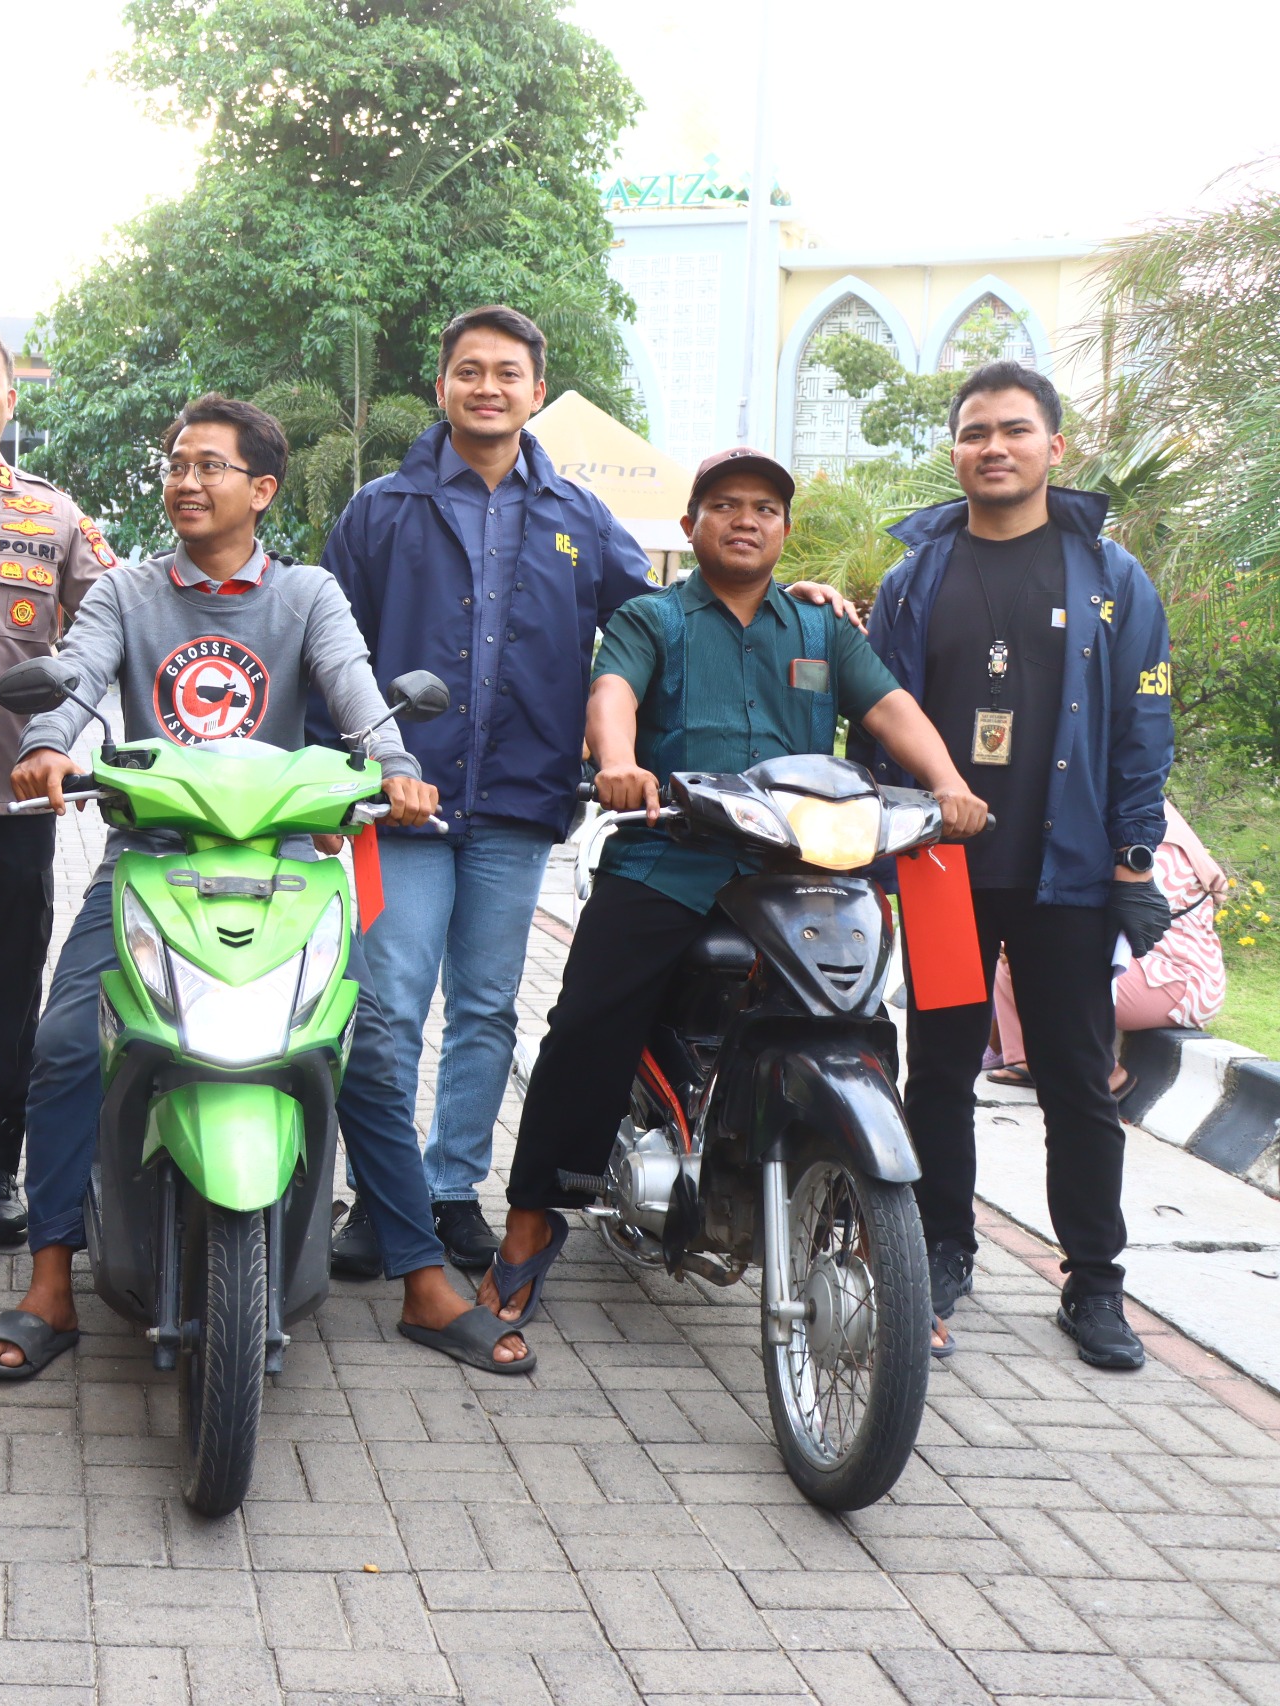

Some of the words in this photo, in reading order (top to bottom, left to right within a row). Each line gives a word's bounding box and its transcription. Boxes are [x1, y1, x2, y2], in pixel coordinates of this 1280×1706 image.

[604, 173, 705, 208] AZIZ
[165, 641, 231, 677] GROSSE
[239, 654, 264, 684] ILE
[795, 886, 848, 896] HONDA
